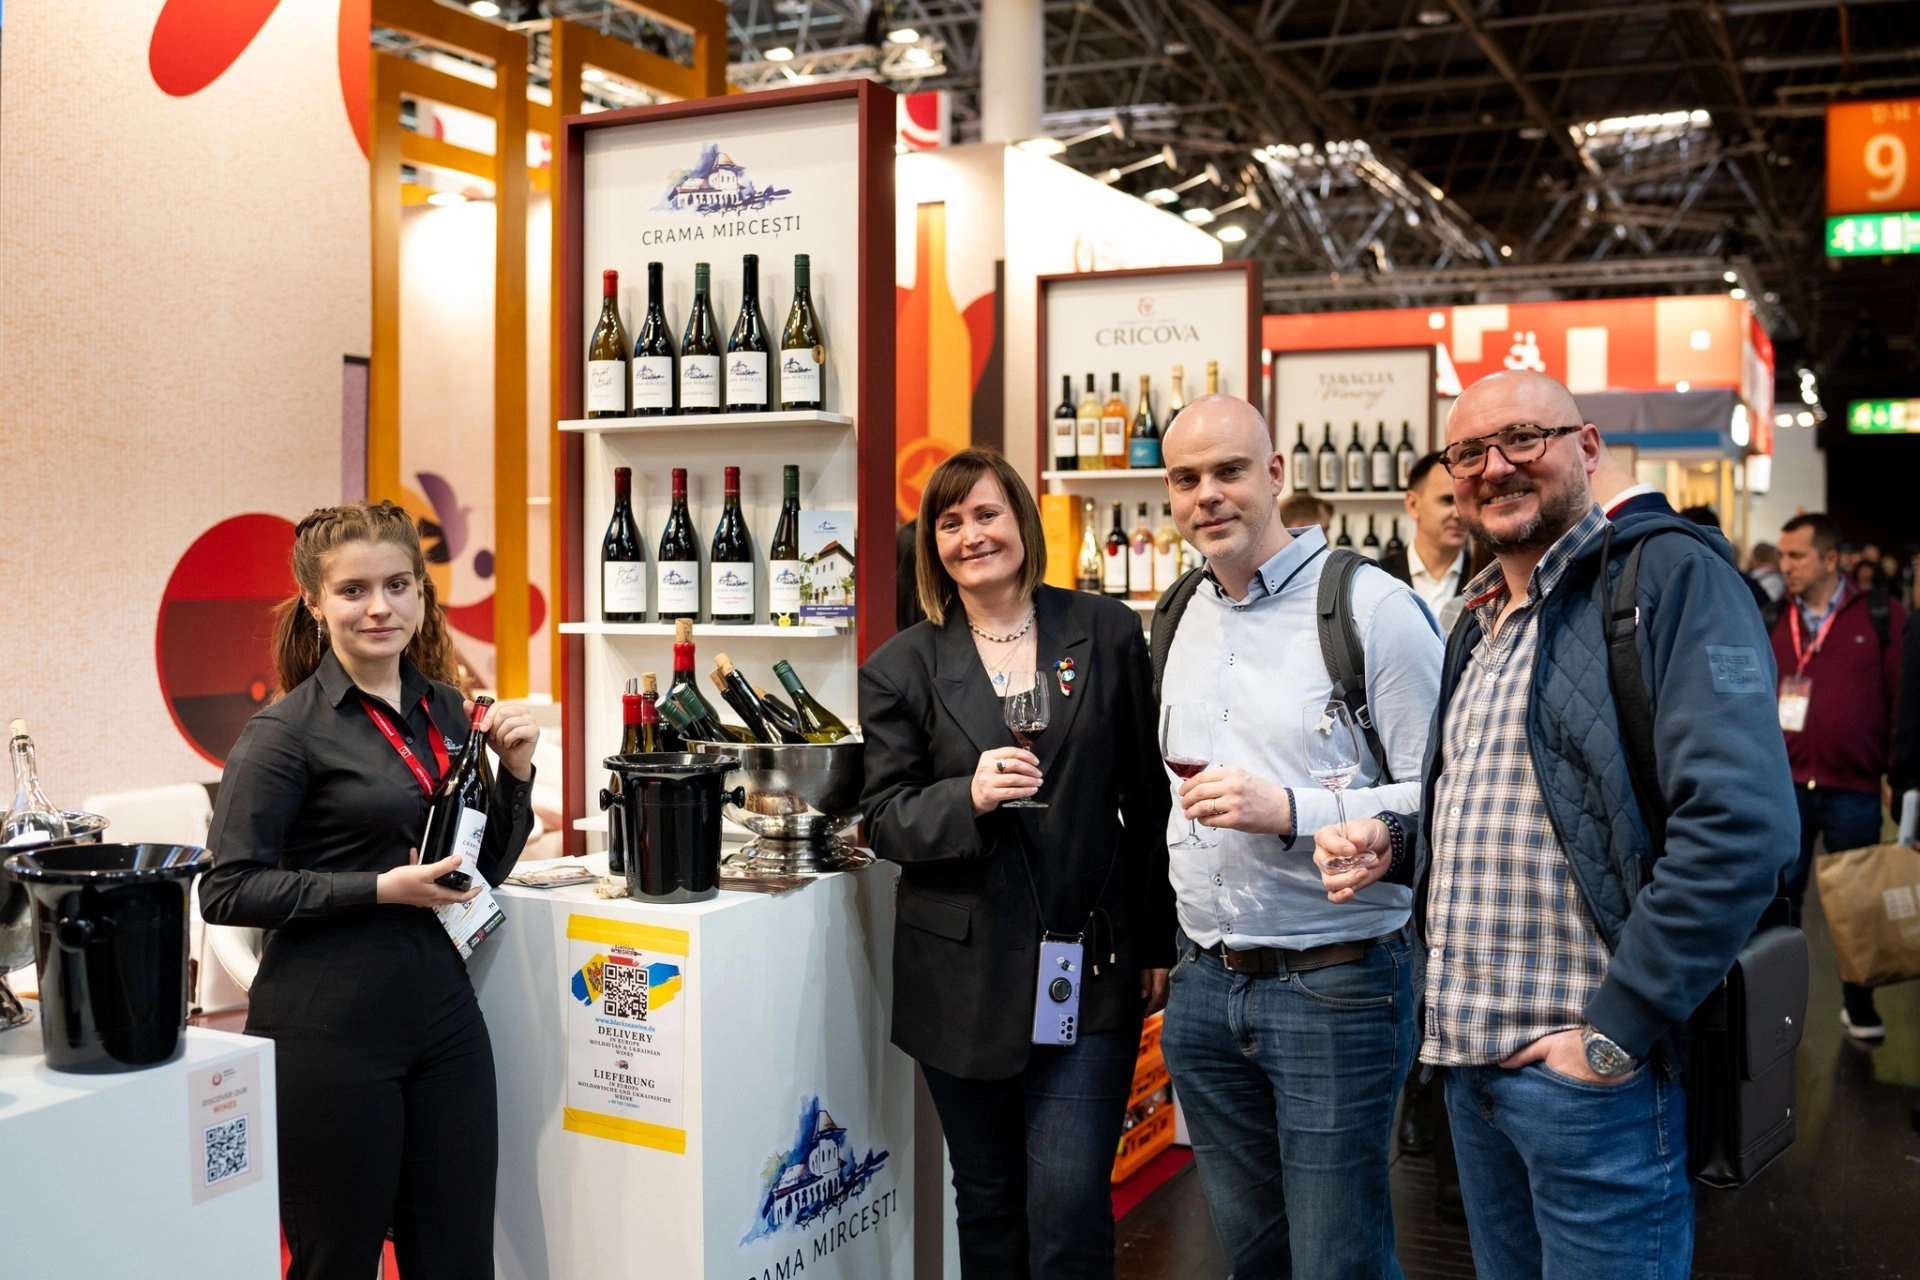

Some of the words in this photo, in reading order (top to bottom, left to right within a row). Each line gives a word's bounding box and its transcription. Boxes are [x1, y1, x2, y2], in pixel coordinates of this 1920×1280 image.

[1863, 133, 1909, 202] 9
[642, 225, 704, 246] CRAMA
[713, 215, 801, 238] MIRCEȘTI
[1095, 324, 1200, 348] CRICOVA
[598, 1025, 653, 1043] DELIVERY
[618, 1038, 640, 1047] EUROPE
[615, 1049, 634, 1057] WINES
[629, 1046, 661, 1056] UKRAINIAN
[593, 1069, 656, 1089] LIEFERUNG
[617, 1083, 639, 1091] EUROPA
[577, 1081, 618, 1093] MOLDAWISCHE
[632, 1091, 672, 1104] UKRAINISCHE
[614, 1094, 633, 1102] WEINE
[813, 1189, 897, 1263] MIRCEȘTI
